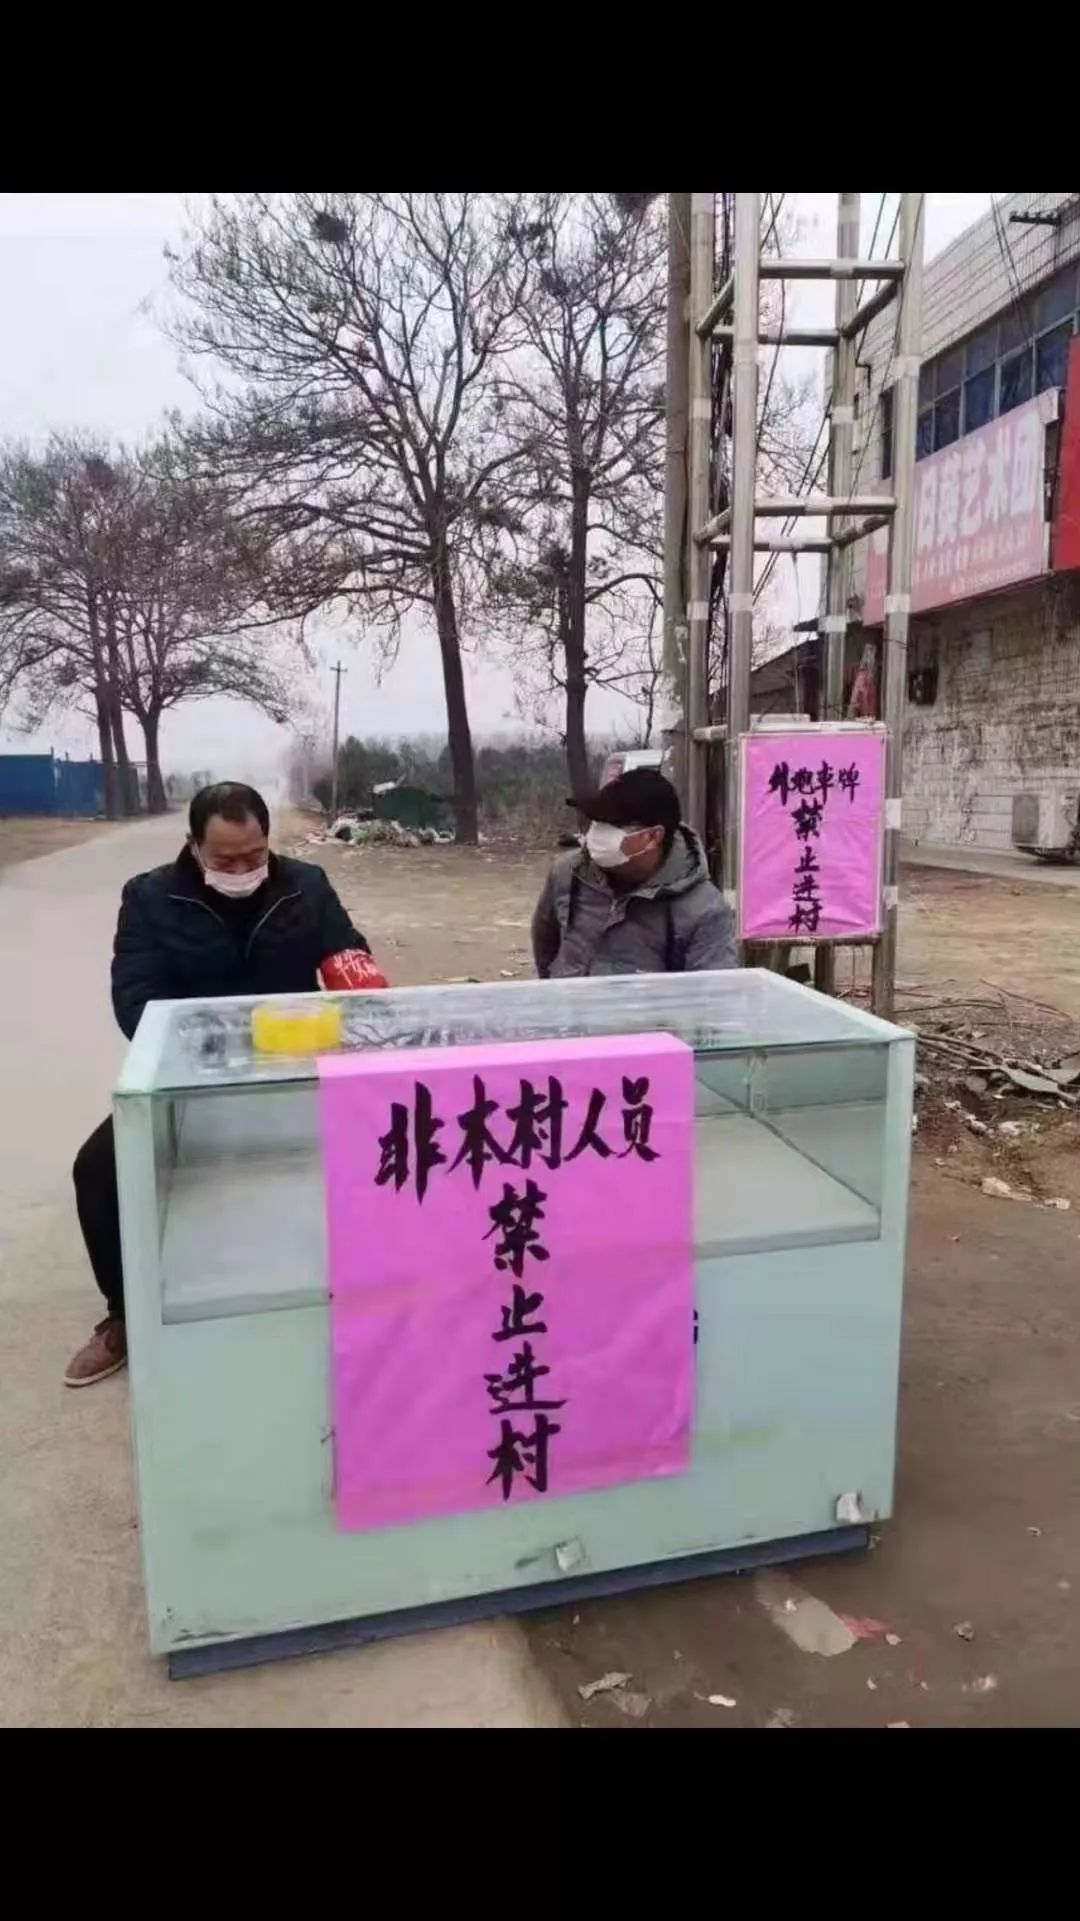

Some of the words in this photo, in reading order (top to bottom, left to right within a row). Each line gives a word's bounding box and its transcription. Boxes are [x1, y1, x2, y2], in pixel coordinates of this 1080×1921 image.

[767, 760, 861, 807] 外地车牌
[788, 797, 823, 935] 禁止进村
[374, 1074, 661, 1205] 非本村人员
[482, 1179, 568, 1500] 禁止进村
